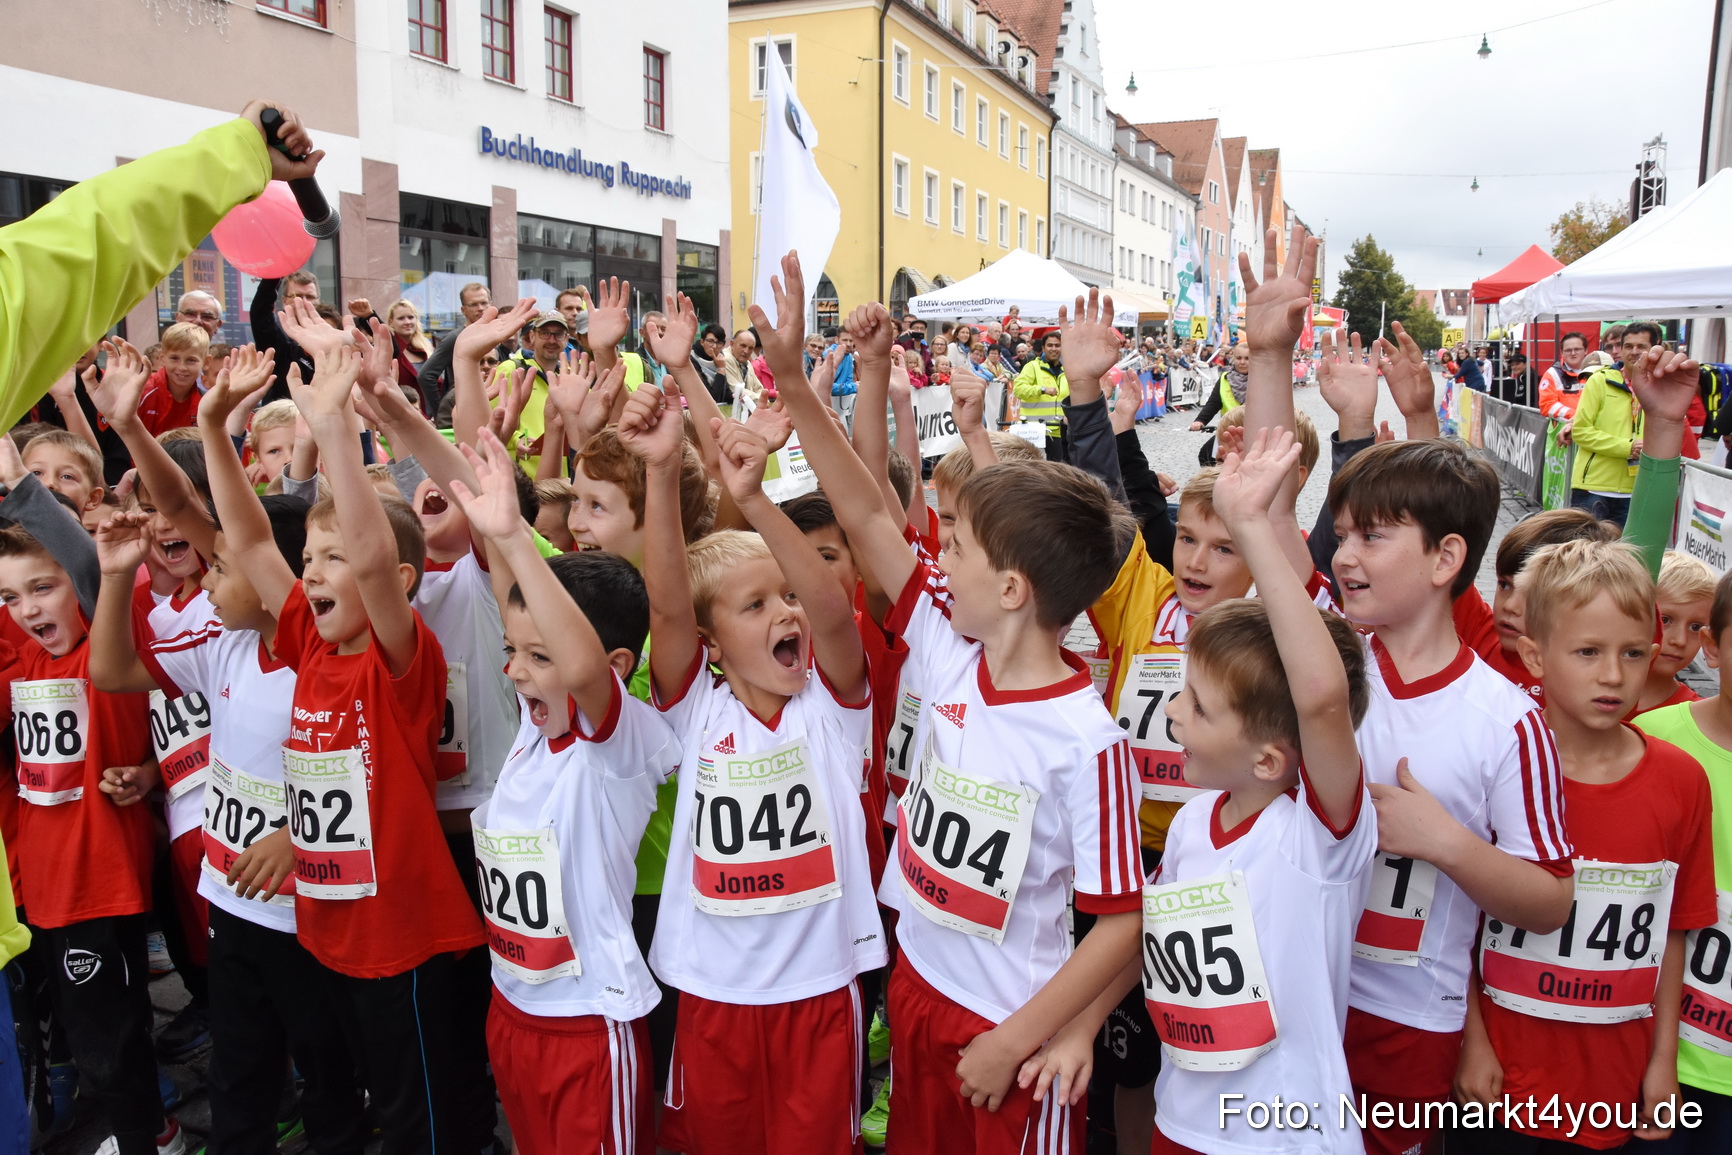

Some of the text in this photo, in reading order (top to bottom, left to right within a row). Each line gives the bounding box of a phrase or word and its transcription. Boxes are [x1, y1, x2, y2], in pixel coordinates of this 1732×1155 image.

[480, 126, 692, 199] Buchhandlung Rupprecht
[193, 259, 214, 272] PANIK
[193, 273, 215, 284] MACHE
[941, 298, 1005, 307] ConnectedDrive
[1194, 323, 1204, 335] A
[1445, 334, 1453, 343] A
[1456, 331, 1462, 339] B
[1685, 531, 1726, 572] NeuerMarkt
[1138, 670, 1182, 679] NeuerMarkt
[17, 683, 77, 701] BOCK
[935, 705, 965, 729] adidas
[12, 710, 82, 757] 068
[355, 699, 373, 791] BAMBINI
[457, 742, 463, 750] K
[164, 750, 206, 782] Simon
[288, 755, 350, 776] BOCK
[727, 746, 804, 780] BOCK
[1144, 757, 1186, 781] Leo
[25, 768, 46, 788] Paul
[729, 766, 806, 788] inspired by smart concepts
[934, 767, 1021, 816] BOCK
[932, 784, 1019, 823] inspired by smart concepts
[359, 837, 367, 848] K
[475, 829, 544, 855] BOCK
[819, 833, 827, 844] K
[714, 871, 785, 894] Jonas
[902, 850, 949, 905] Lukas
[1578, 867, 1663, 888] BOCK
[476, 857, 549, 930] 020
[999, 889, 1008, 899] K
[1143, 881, 1231, 916] BOCK
[1577, 885, 1605, 893] inspired
[1606, 886, 1615, 894] by
[1169, 914, 1178, 922] by
[1179, 910, 1201, 919] smart
[1201, 905, 1234, 916] concepts
[1414, 908, 1423, 918] K
[553, 926, 563, 936] K
[1489, 939, 1497, 949] 4
[67, 956, 96, 967] saller
[1650, 953, 1658, 965] K
[1252, 986, 1262, 999] K
[1538, 971, 1612, 1002] Quirin
[1163, 1012, 1215, 1045] Simon
